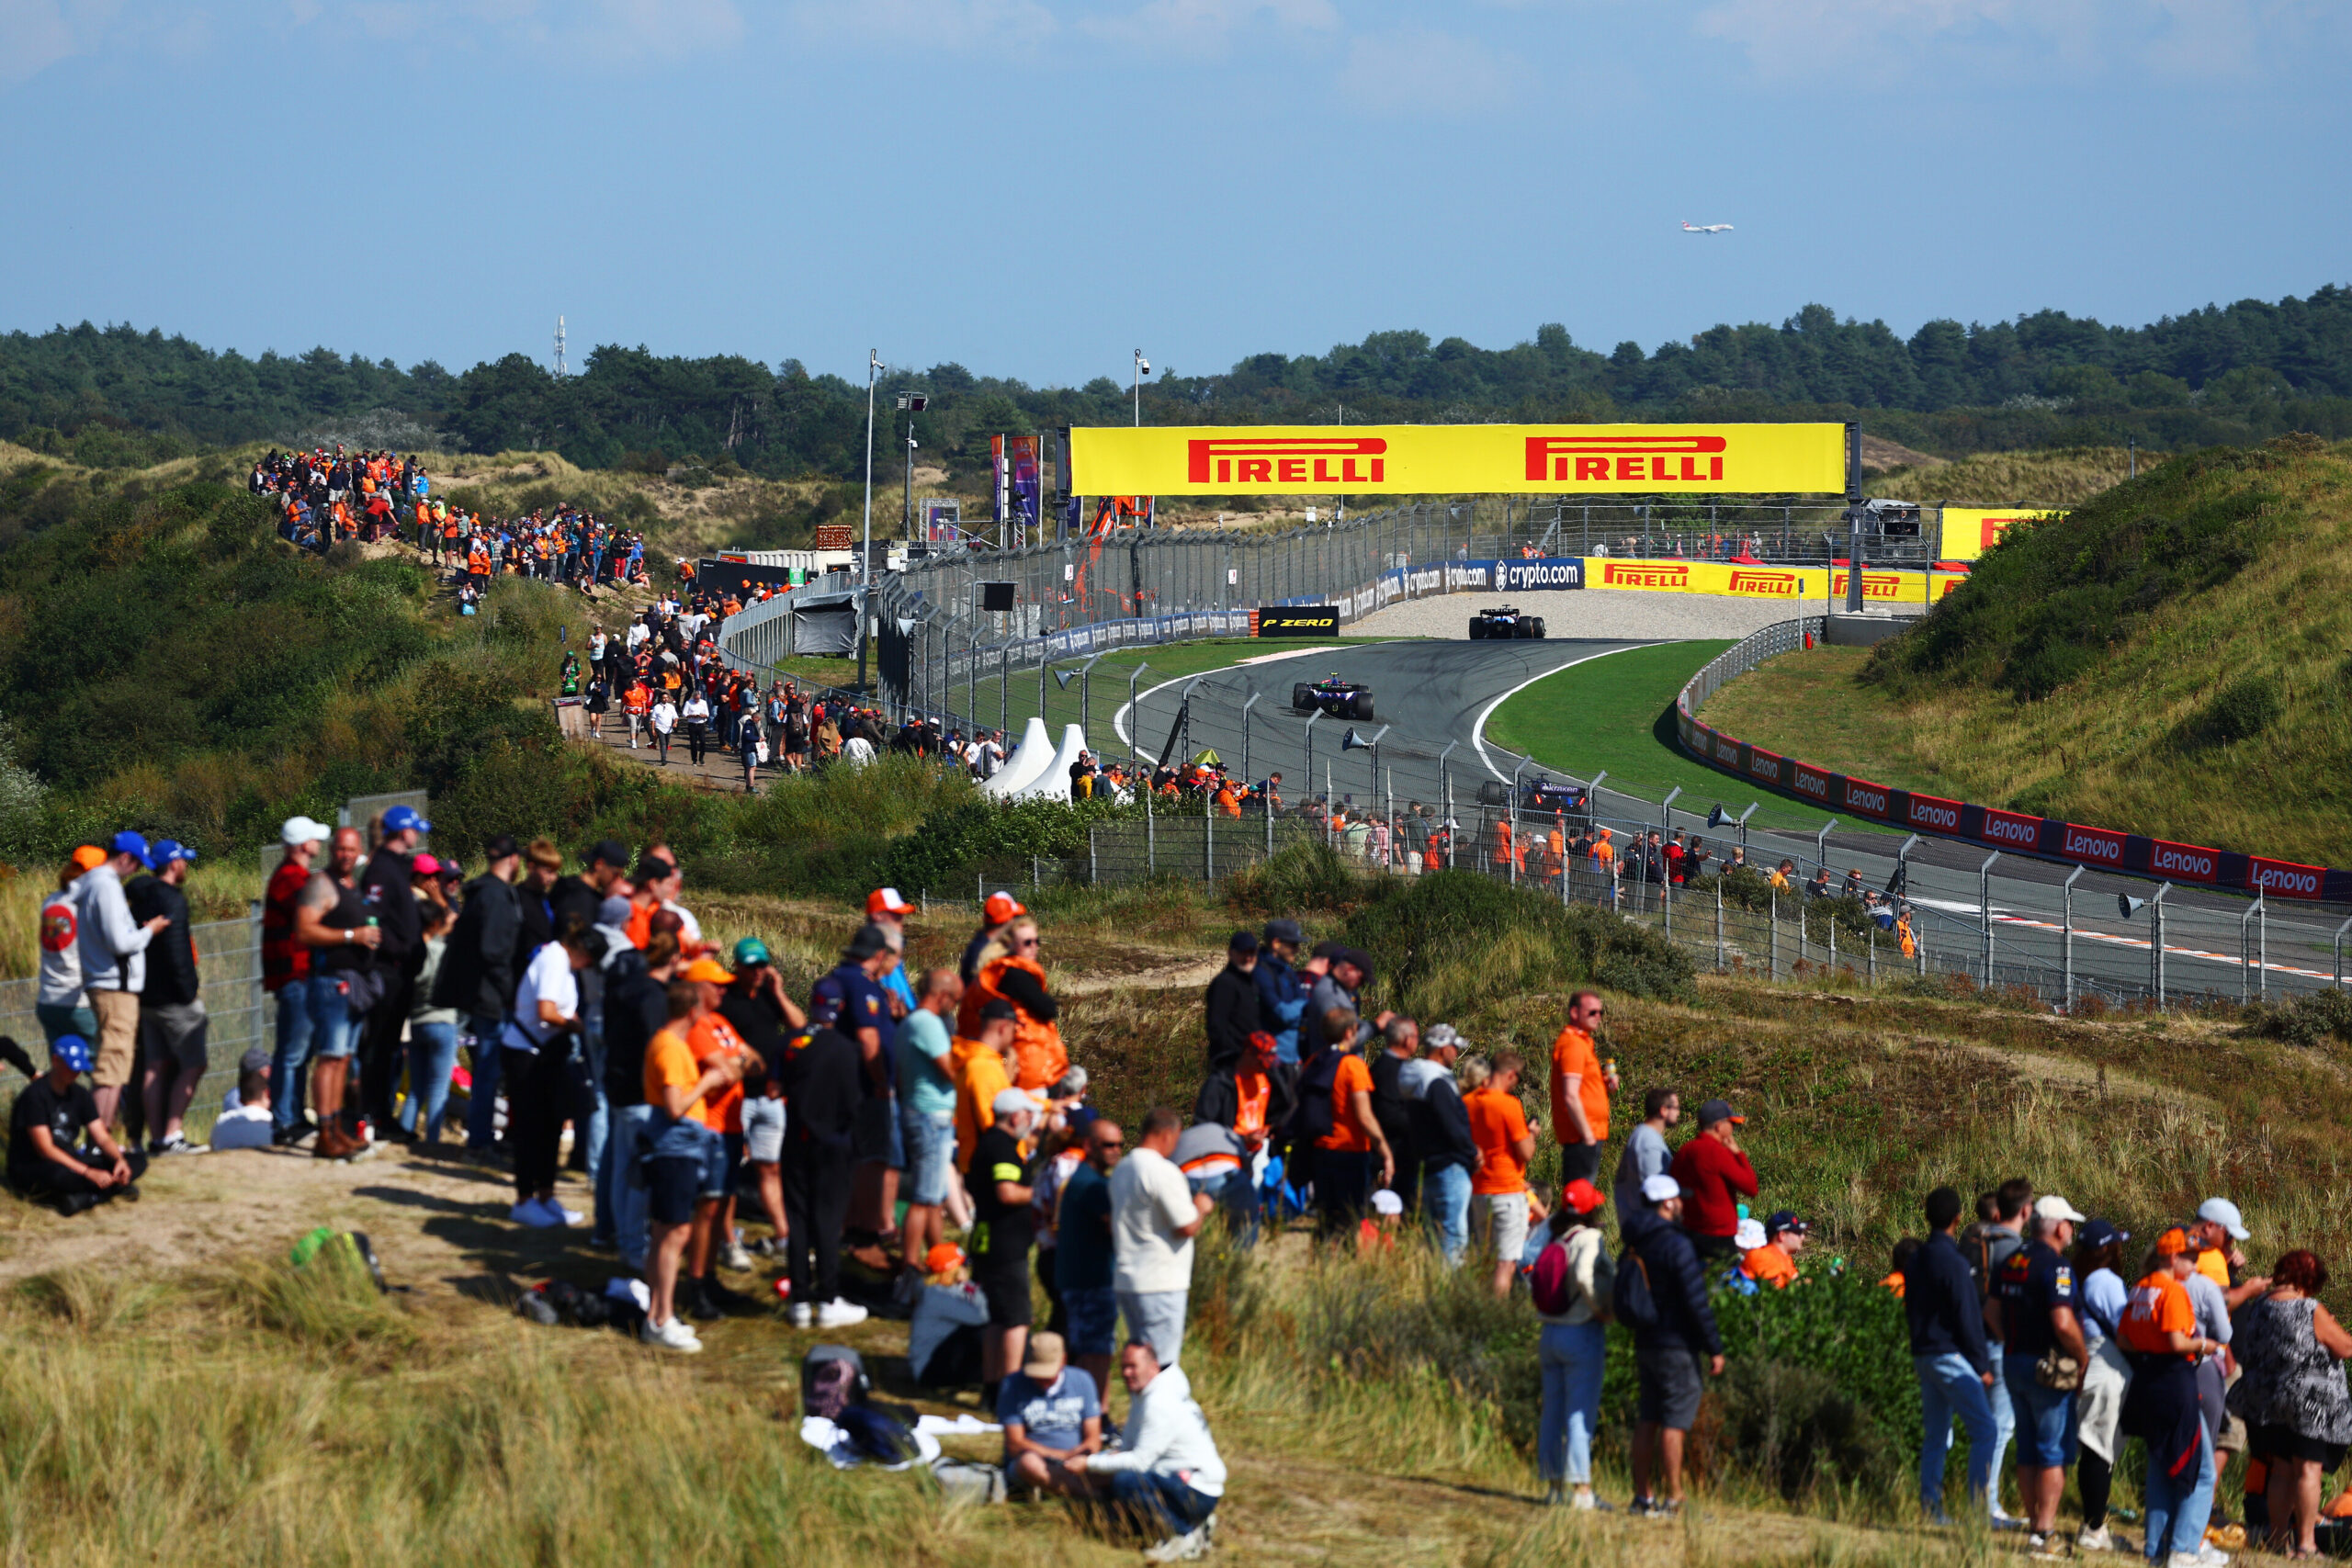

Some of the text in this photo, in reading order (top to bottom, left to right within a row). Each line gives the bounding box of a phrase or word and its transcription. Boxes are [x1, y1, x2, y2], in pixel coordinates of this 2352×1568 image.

[1188, 438, 1387, 483] PIRELLI
[1525, 436, 1727, 481] PIRELLI
[1510, 562, 1578, 589] crypto.com
[1604, 563, 1690, 587] PIRELLI
[1728, 570, 1796, 594] PIRELLI
[1833, 574, 1901, 597] PIELLI
[1262, 618, 1333, 627] P ZERO
[1751, 751, 1778, 778] Lenovo
[1548, 783, 1578, 793] kraken
[1795, 766, 1825, 795] Lenovo
[1847, 784, 1884, 812] Lenovo
[1911, 799, 1956, 827] Lenovo
[1984, 814, 2035, 842] Lenovo
[2065, 829, 2119, 859] Lenovo
[2154, 846, 2211, 874] Lenovo
[2252, 863, 2317, 892] Lenovo
